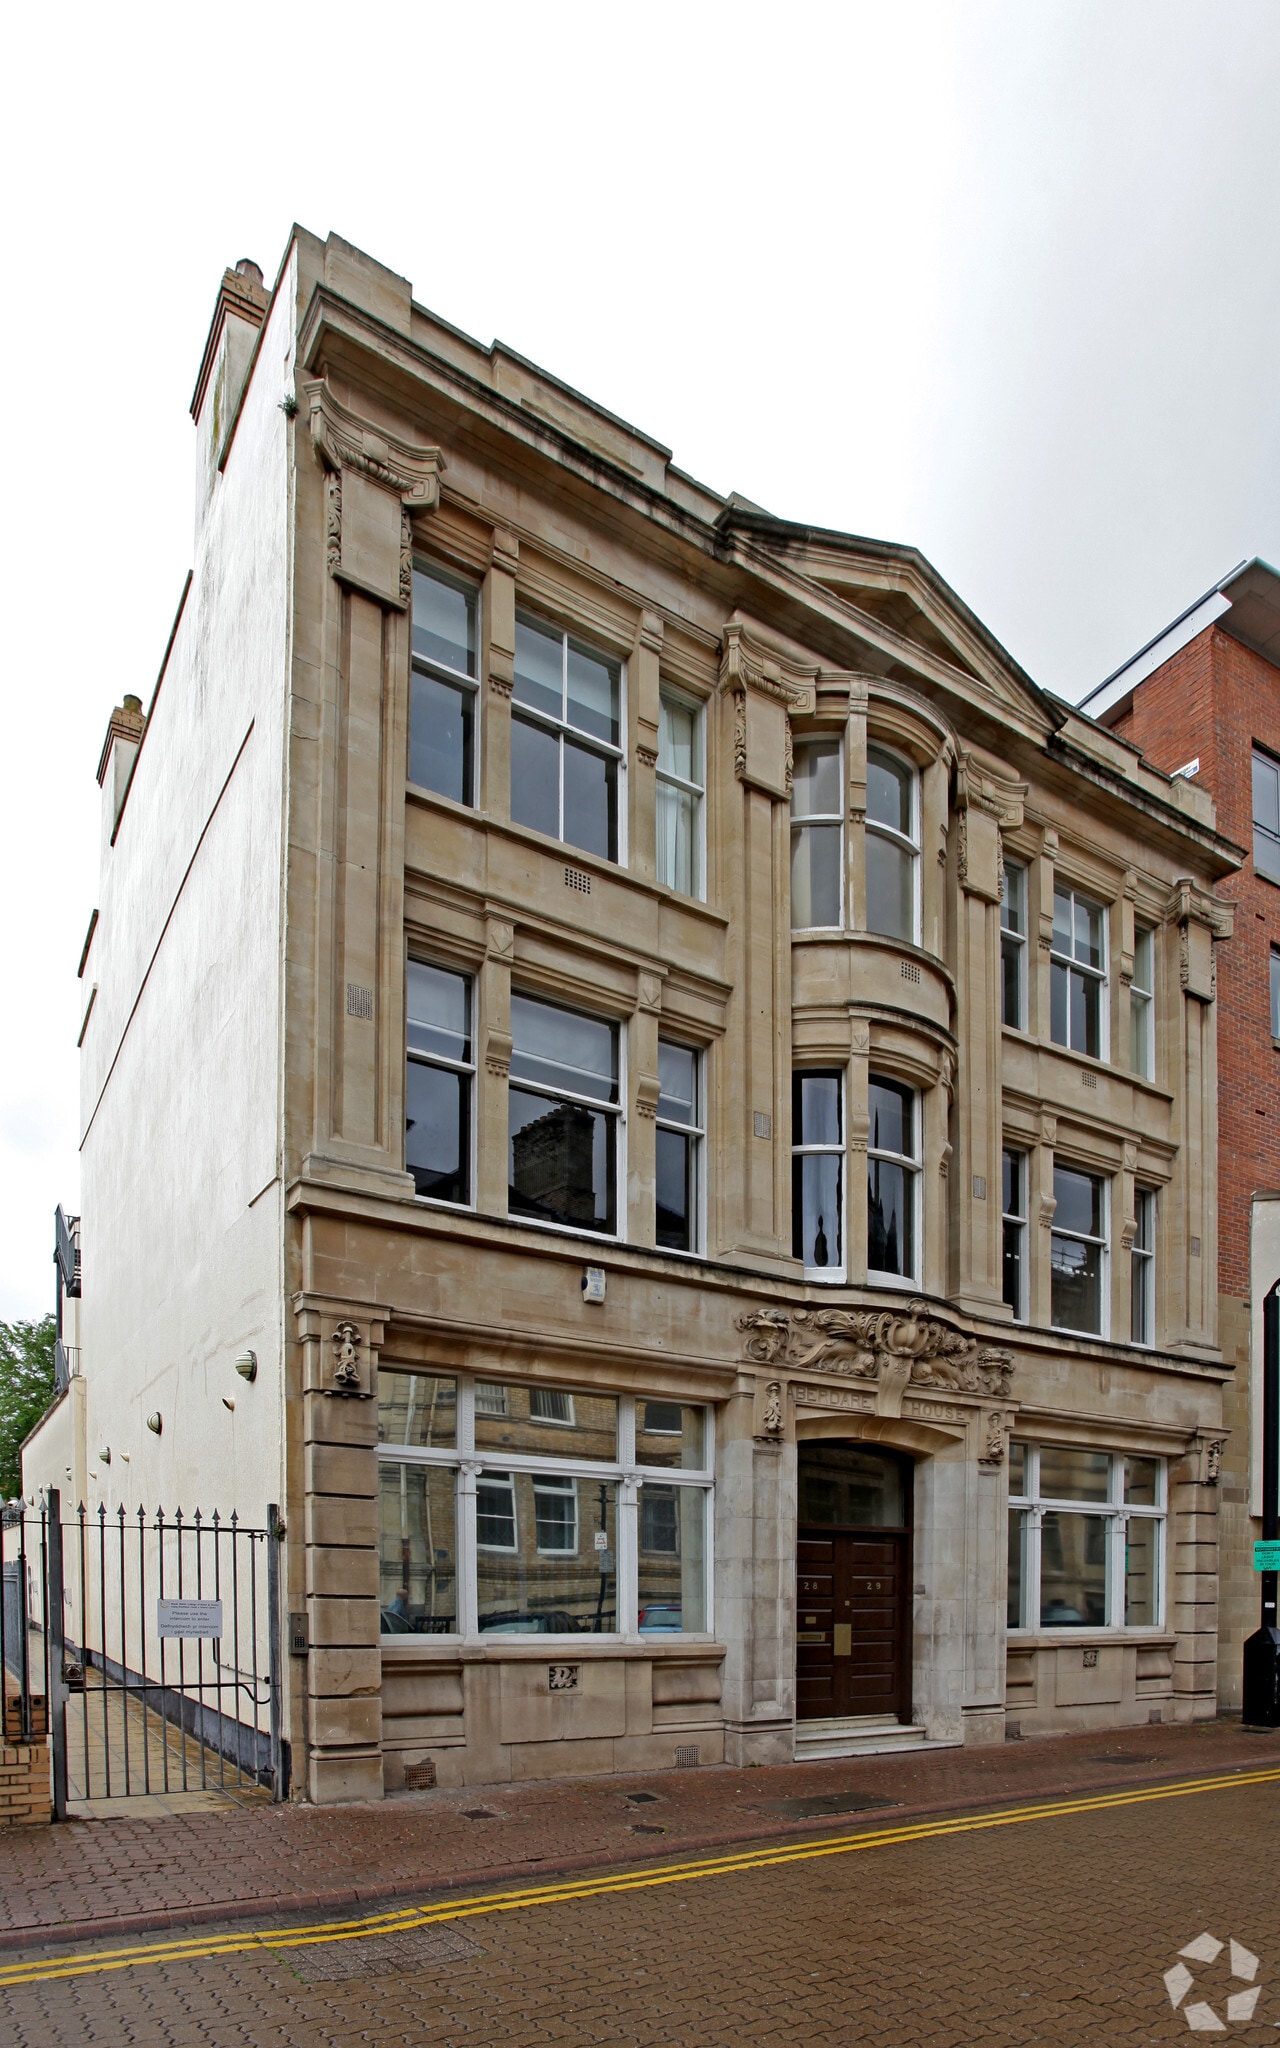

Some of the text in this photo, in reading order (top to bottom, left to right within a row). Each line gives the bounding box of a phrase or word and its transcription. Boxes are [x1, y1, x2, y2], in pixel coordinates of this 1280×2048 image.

[786, 1385, 965, 1421] ABERDARE HOUSE
[803, 1581, 818, 1590] 28
[866, 1582, 881, 1590] 29
